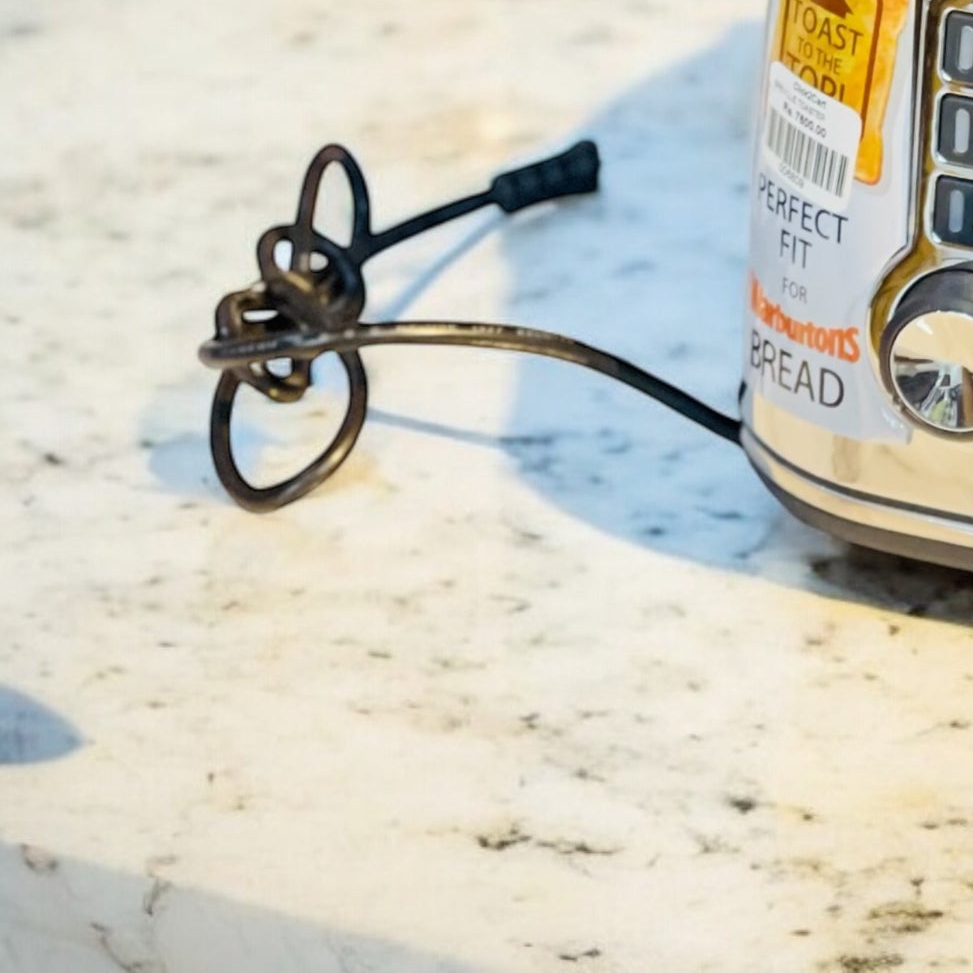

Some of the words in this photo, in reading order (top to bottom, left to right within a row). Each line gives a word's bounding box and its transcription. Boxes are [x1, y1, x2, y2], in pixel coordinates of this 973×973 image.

[797, 36, 813, 59] TO
[816, 47, 842, 75] THE
[758, 172, 849, 244] PERFECT
[780, 229, 812, 269] FIT
[782, 276, 807, 304] FOR
[750, 329, 844, 408] BREAD
